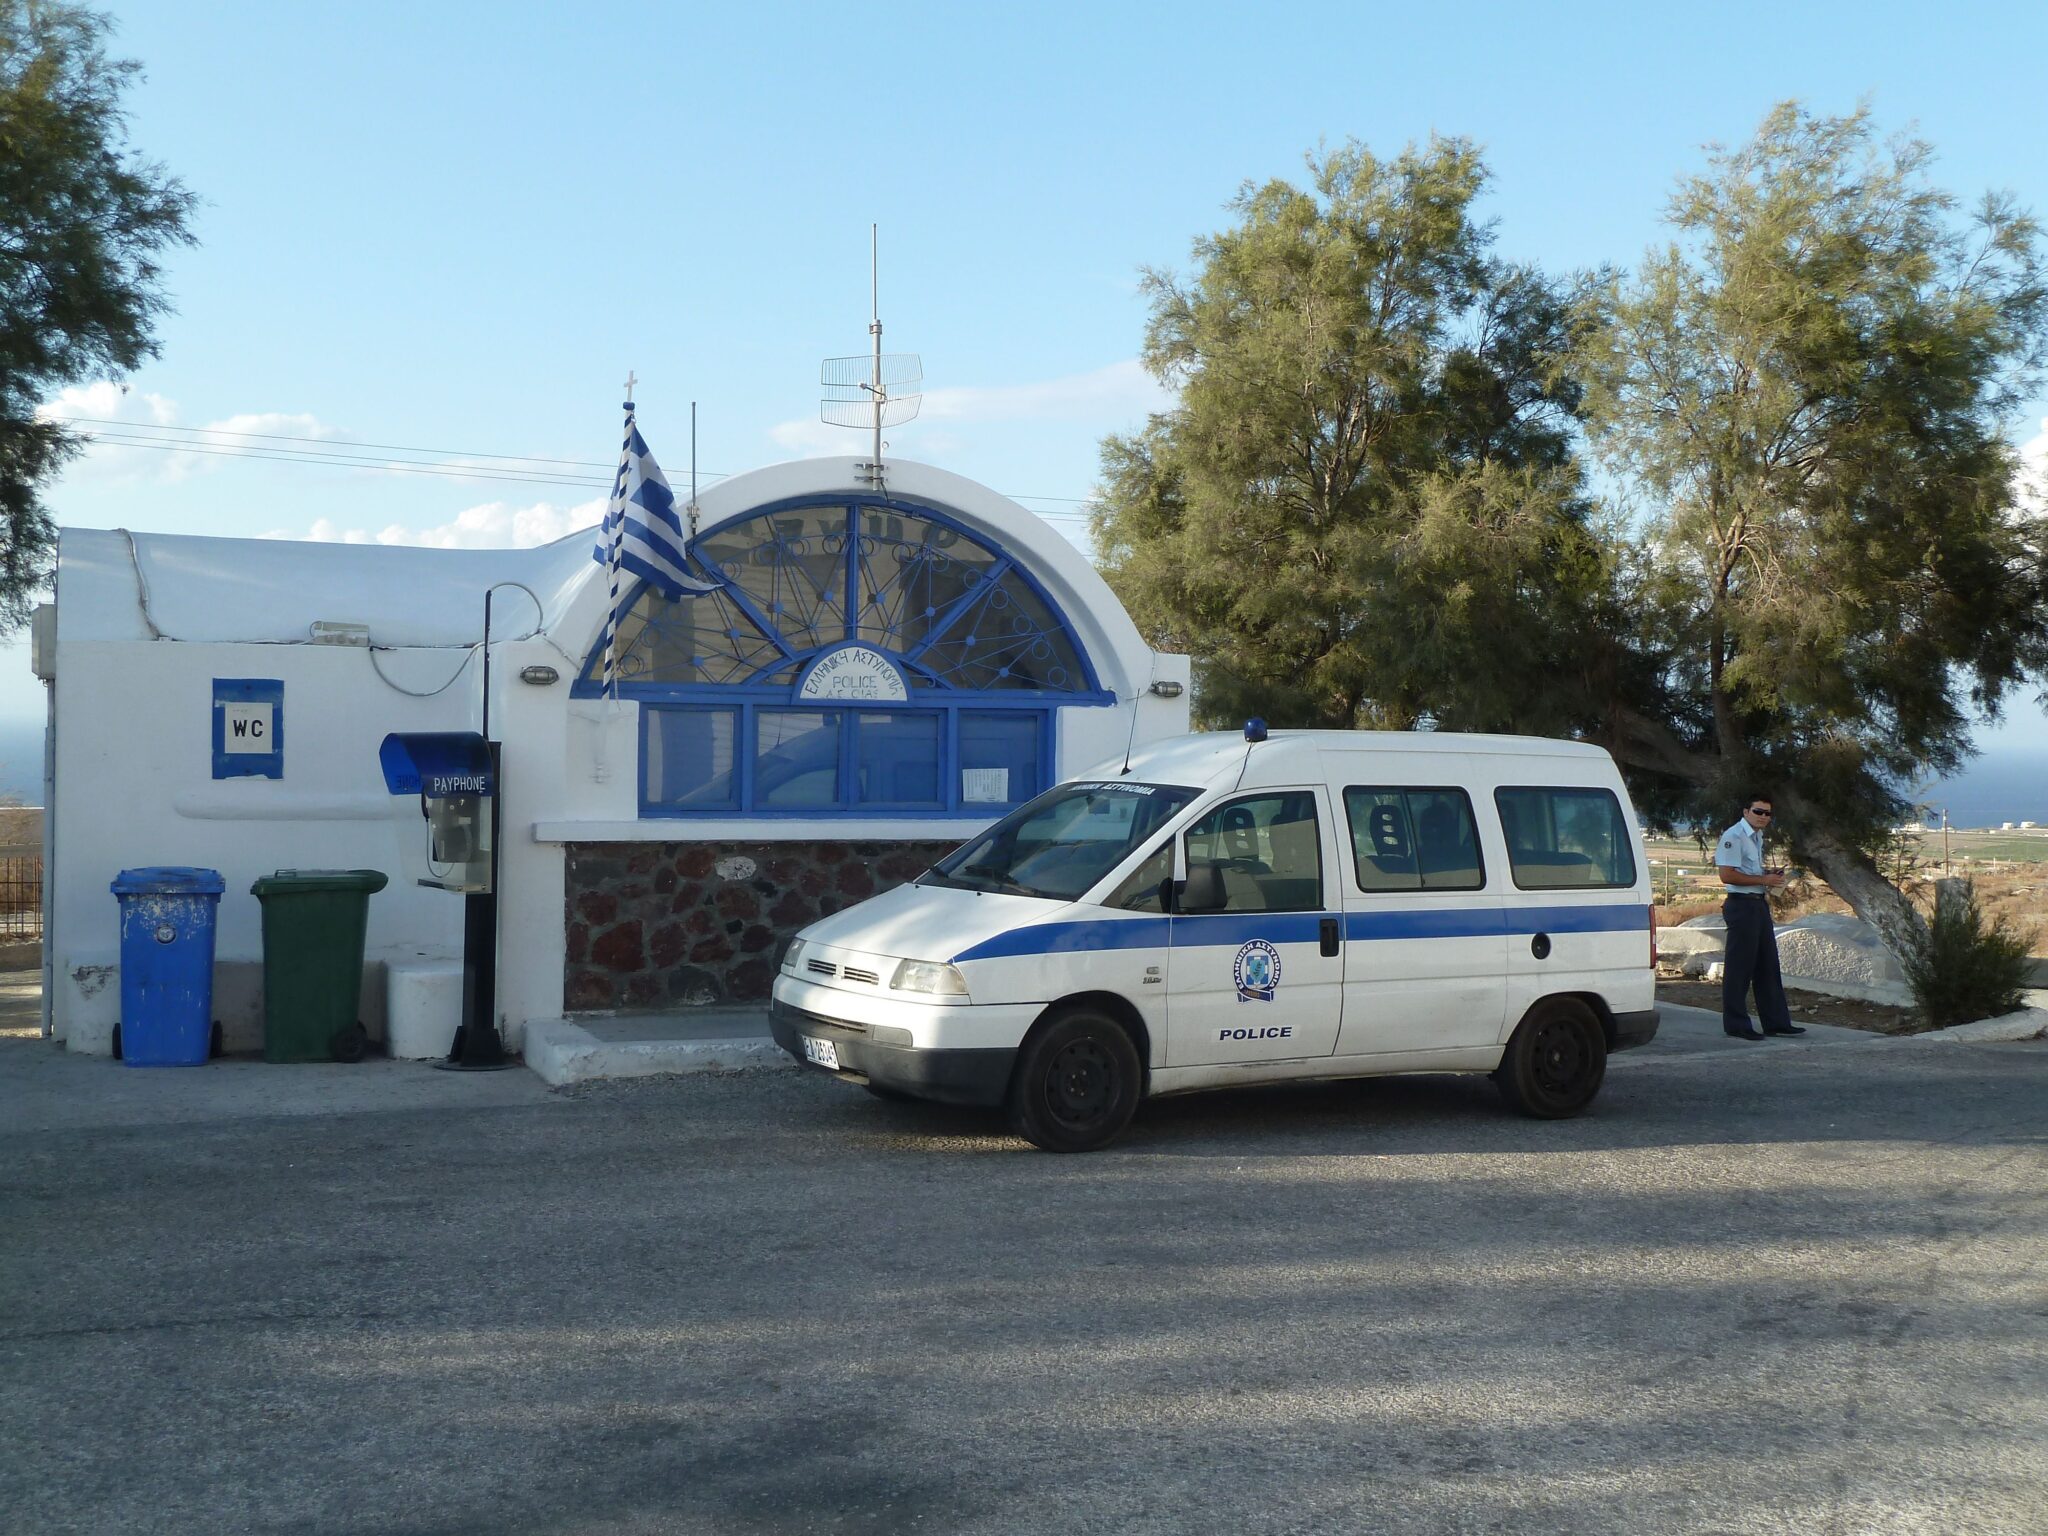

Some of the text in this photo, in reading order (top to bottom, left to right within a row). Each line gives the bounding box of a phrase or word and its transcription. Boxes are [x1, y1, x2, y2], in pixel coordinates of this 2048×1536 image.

[832, 675, 877, 689] POLICE
[232, 719, 264, 738] WC
[433, 776, 486, 792] PAYPHONE
[1219, 1026, 1293, 1041] POLICE
